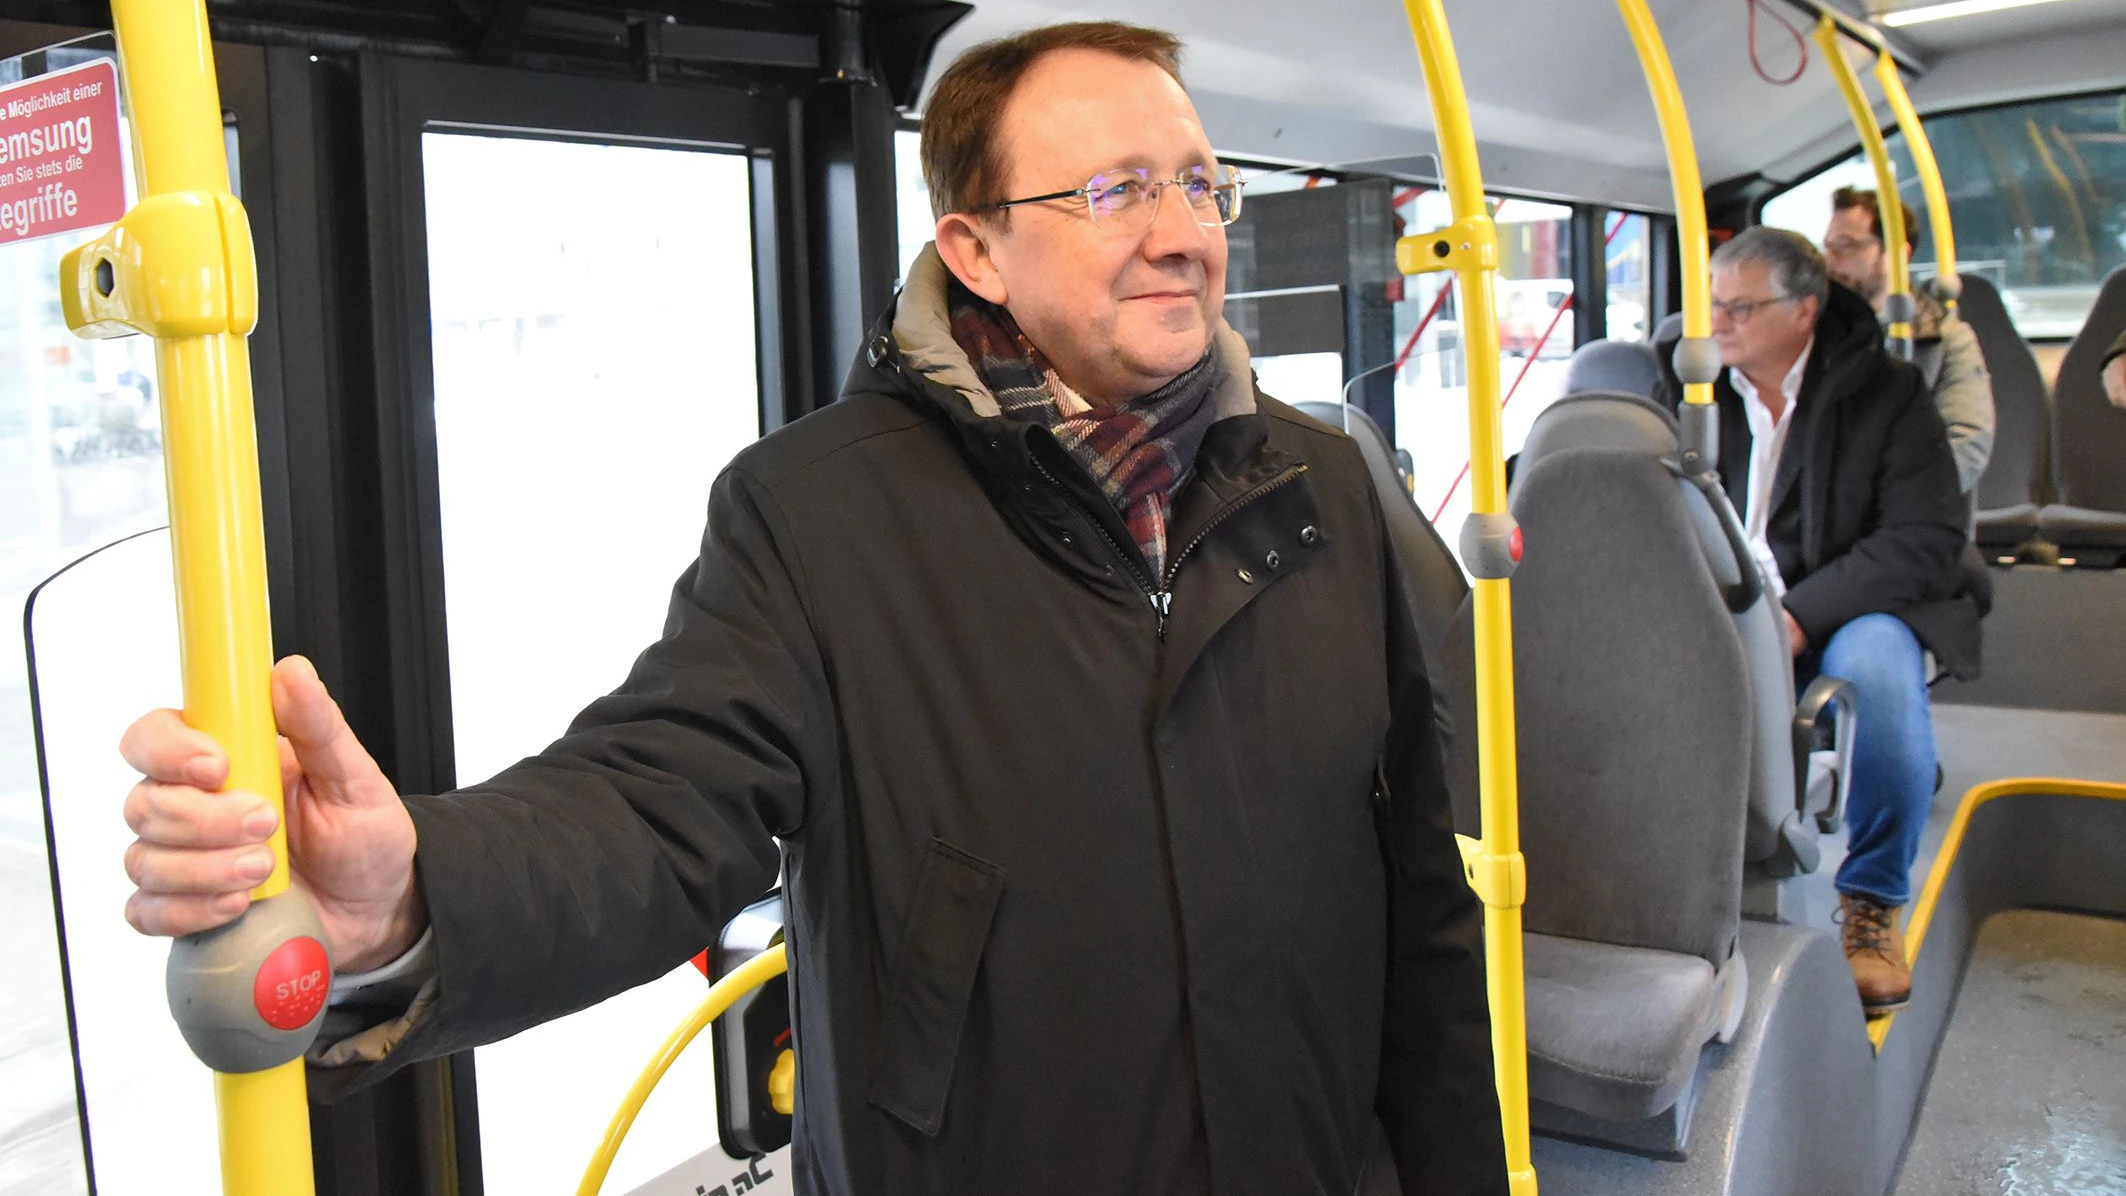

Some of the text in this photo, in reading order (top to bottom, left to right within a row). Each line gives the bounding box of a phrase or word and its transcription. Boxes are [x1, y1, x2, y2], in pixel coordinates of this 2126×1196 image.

[8, 87, 71, 119] Möglichkeit
[73, 81, 103, 102] einer
[16, 165, 34, 183] Sie
[36, 158, 63, 179] stets
[65, 155, 83, 172] die
[0, 182, 78, 236] egriffe
[275, 970, 321, 1000] STOP
